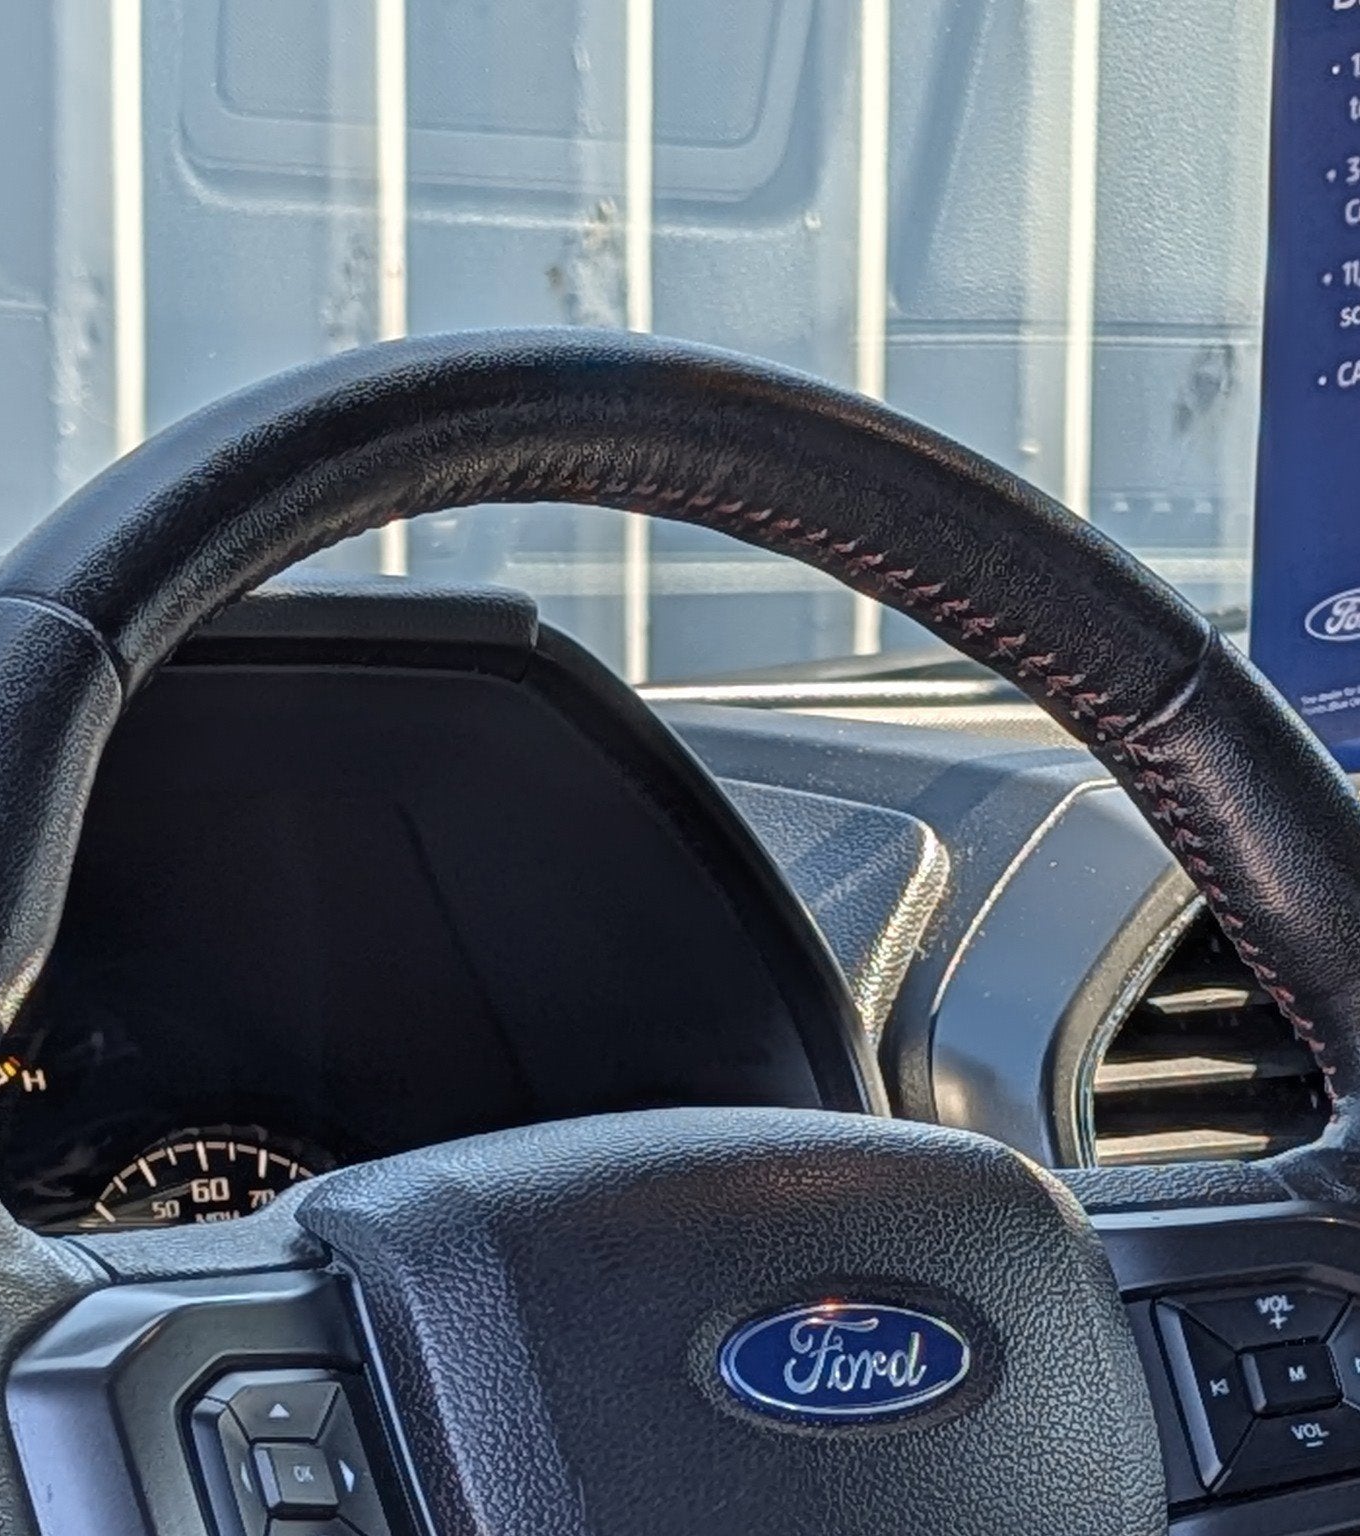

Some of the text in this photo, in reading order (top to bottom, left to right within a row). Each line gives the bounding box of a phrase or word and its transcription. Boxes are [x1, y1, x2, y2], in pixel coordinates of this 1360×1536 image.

[21, 1069, 46, 1092] H
[191, 1177, 230, 1204] 60
[151, 1200, 181, 1220] 50
[1255, 1295, 1295, 1315] VOL
[784, 1317, 928, 1395] Ford
[1288, 1364, 1307, 1382] M
[1291, 1422, 1329, 1440] VOL
[293, 1465, 314, 1482] OK
